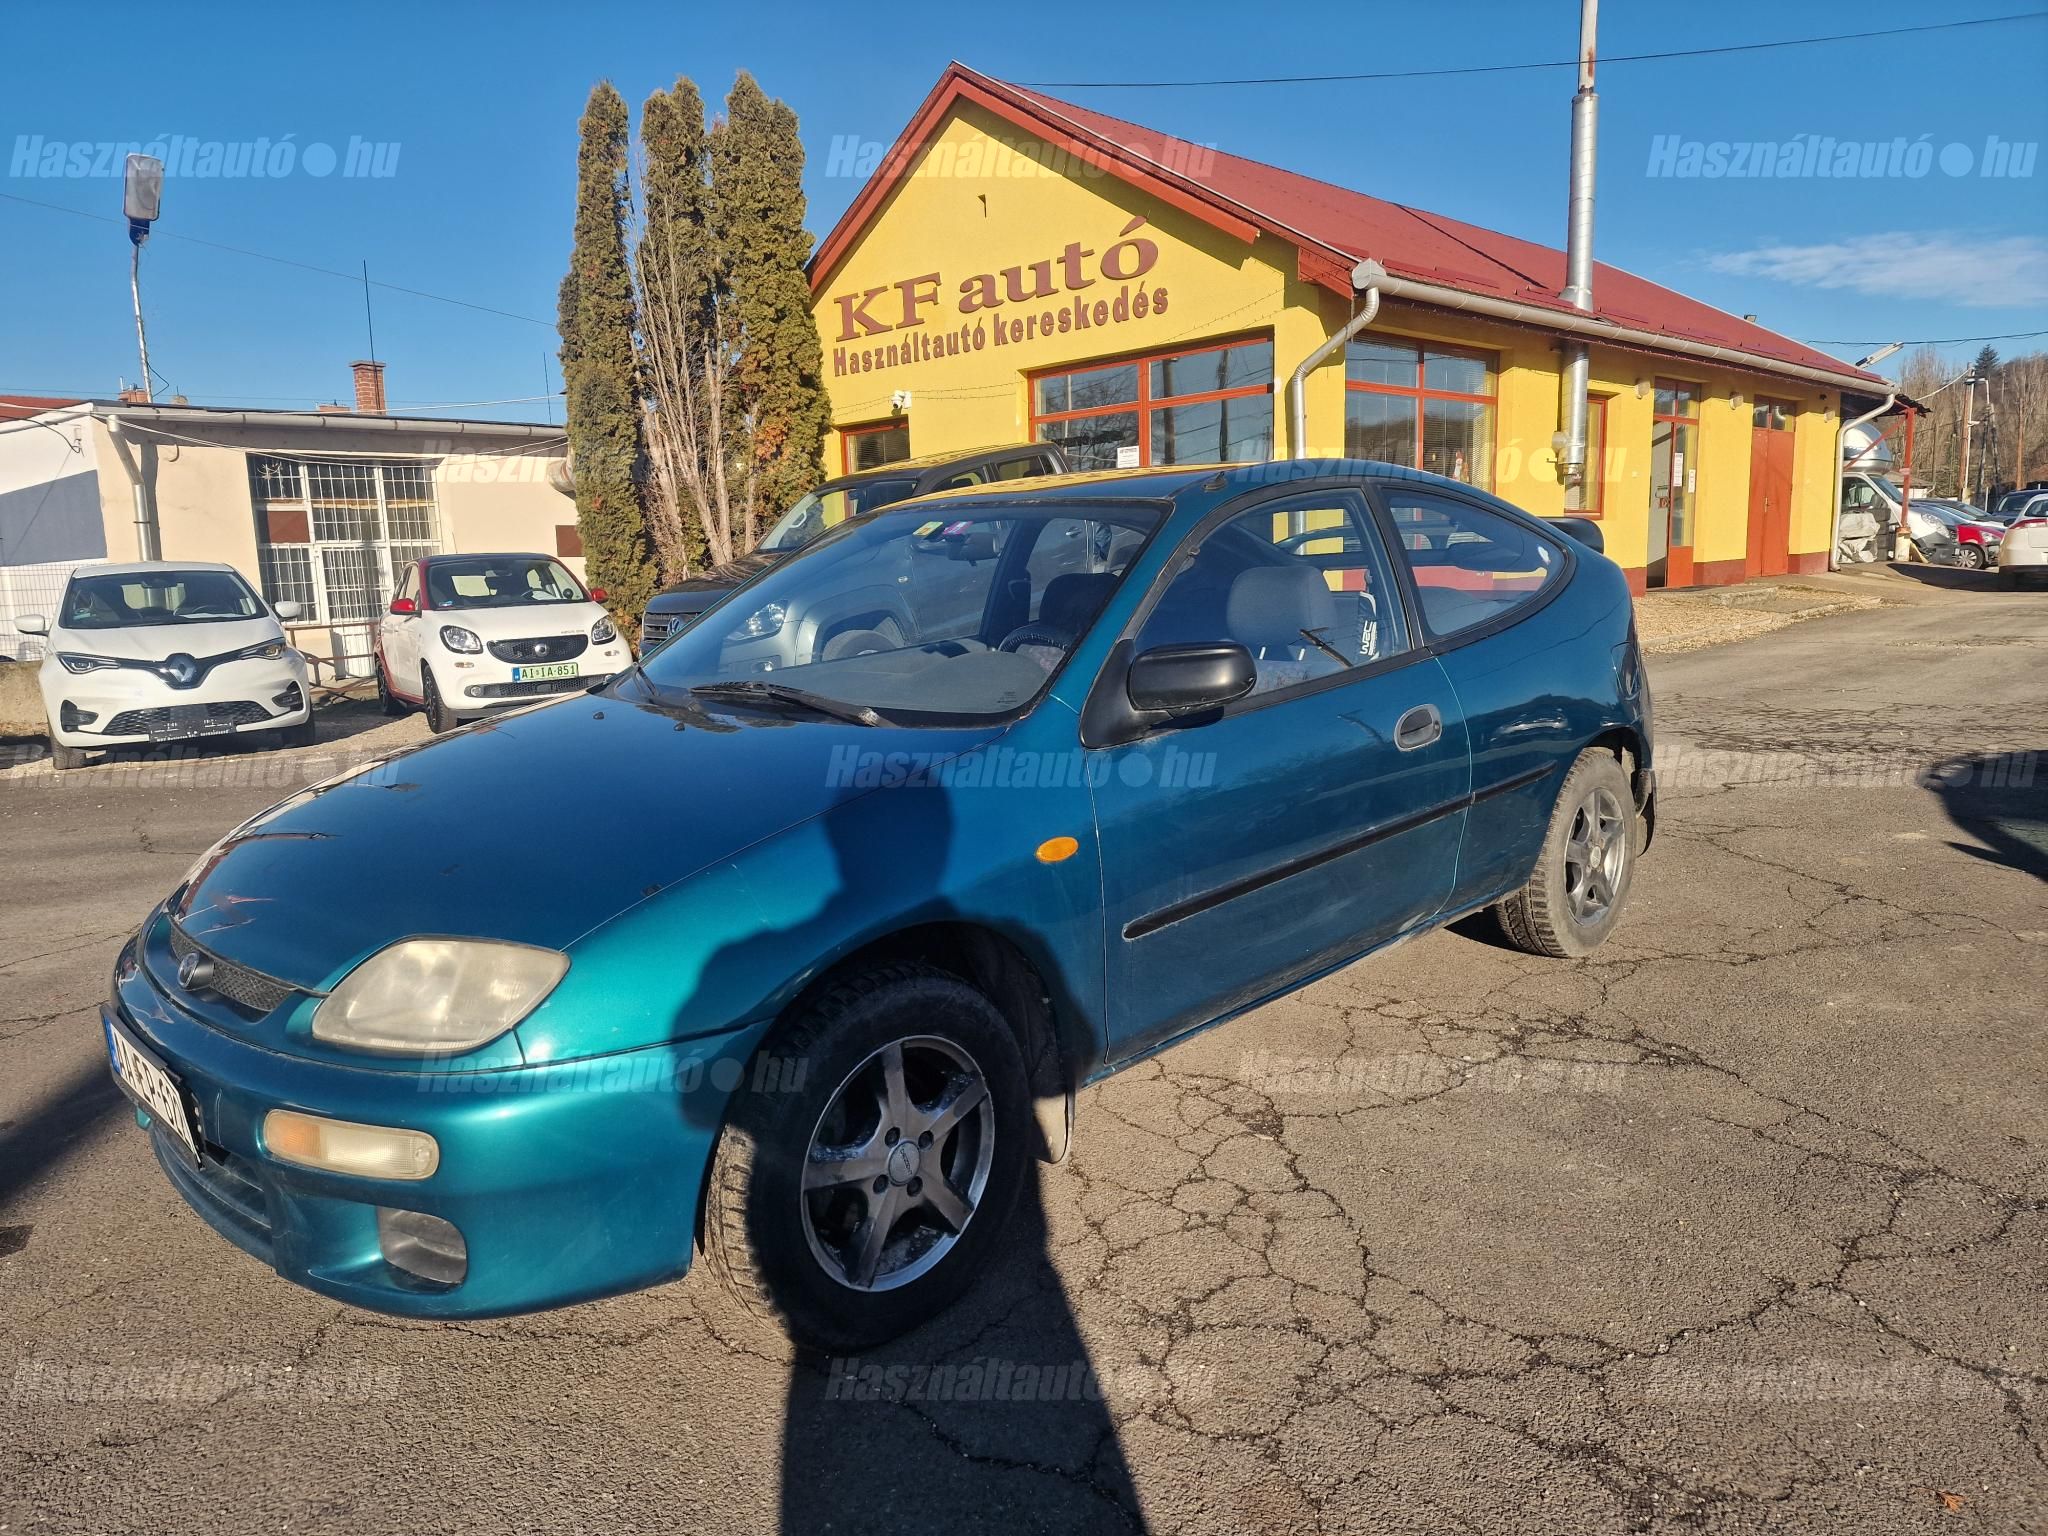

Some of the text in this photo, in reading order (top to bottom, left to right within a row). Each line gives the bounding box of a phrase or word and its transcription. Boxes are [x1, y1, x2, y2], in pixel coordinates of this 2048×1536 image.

[833, 215, 1159, 342] KF autó
[833, 281, 1169, 377] Használtautó kereskedés
